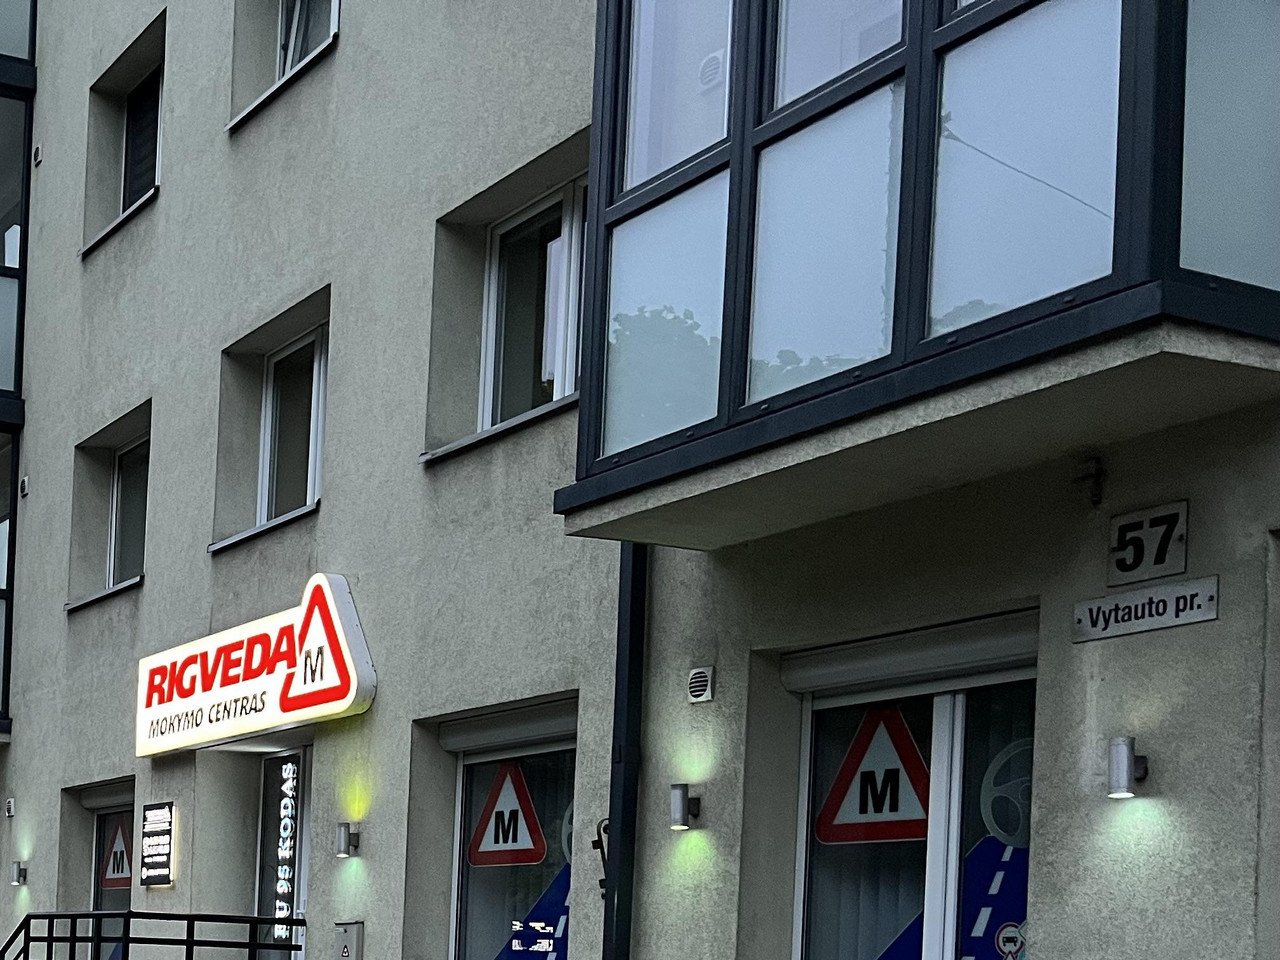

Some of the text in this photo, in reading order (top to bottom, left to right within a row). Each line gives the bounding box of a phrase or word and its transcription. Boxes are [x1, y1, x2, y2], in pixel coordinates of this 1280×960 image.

[1115, 512, 1180, 573] 57
[1088, 592, 1202, 632] Vytauto pr.
[145, 623, 297, 709] RIGVEDA
[303, 645, 325, 686] M
[148, 690, 267, 739] MOKYMO CENTRAS
[277, 762, 298, 860] KODAS
[859, 768, 900, 814] M
[494, 809, 519, 844] M
[112, 850, 125, 875] M
